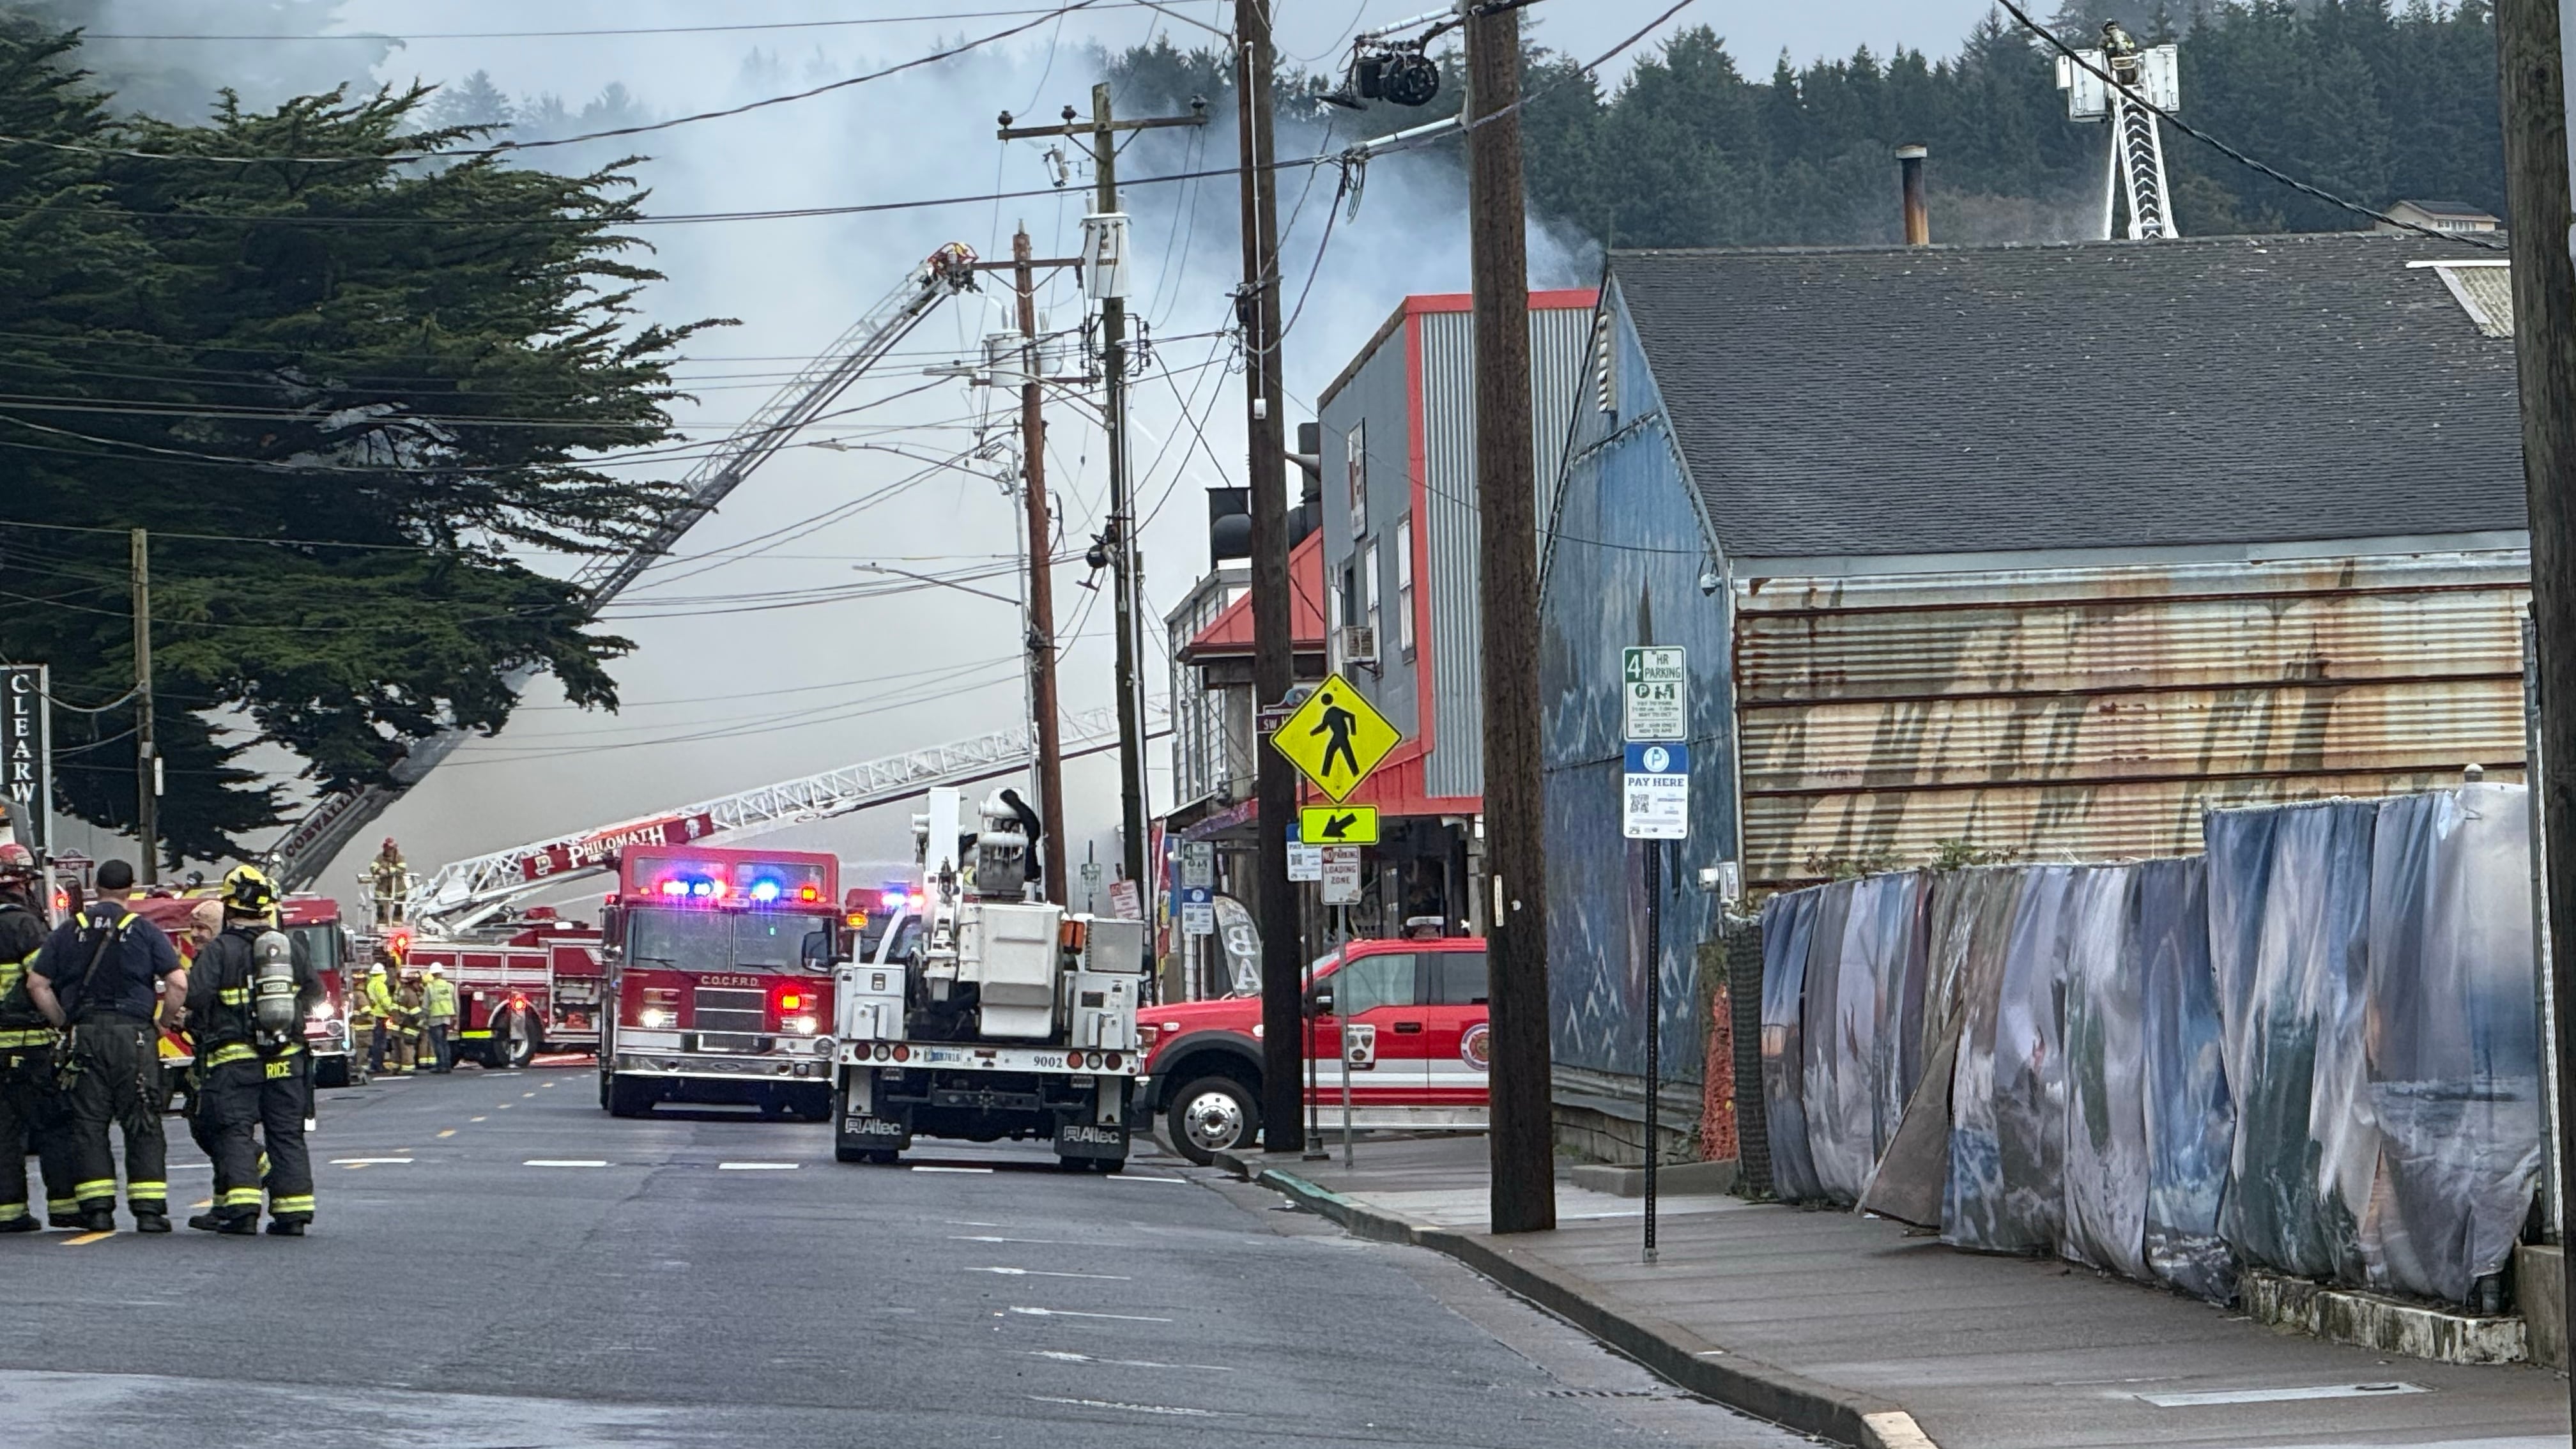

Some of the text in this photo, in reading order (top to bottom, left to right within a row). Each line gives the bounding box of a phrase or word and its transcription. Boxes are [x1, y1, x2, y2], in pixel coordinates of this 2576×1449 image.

[1657, 654, 1669, 664] HR
[1627, 654, 1641, 678] 4
[1644, 667, 1681, 678] PARKING
[1264, 718, 1277, 730] SW
[1628, 777, 1685, 787] PAY HERE
[568, 824, 666, 868] PHILOMATH
[1331, 876, 1350, 884] ZONE
[1034, 1055, 1062, 1068] 9002
[266, 1061, 292, 1079] RICE
[862, 1119, 901, 1135] Altec
[1080, 1126, 1120, 1144] Altec
